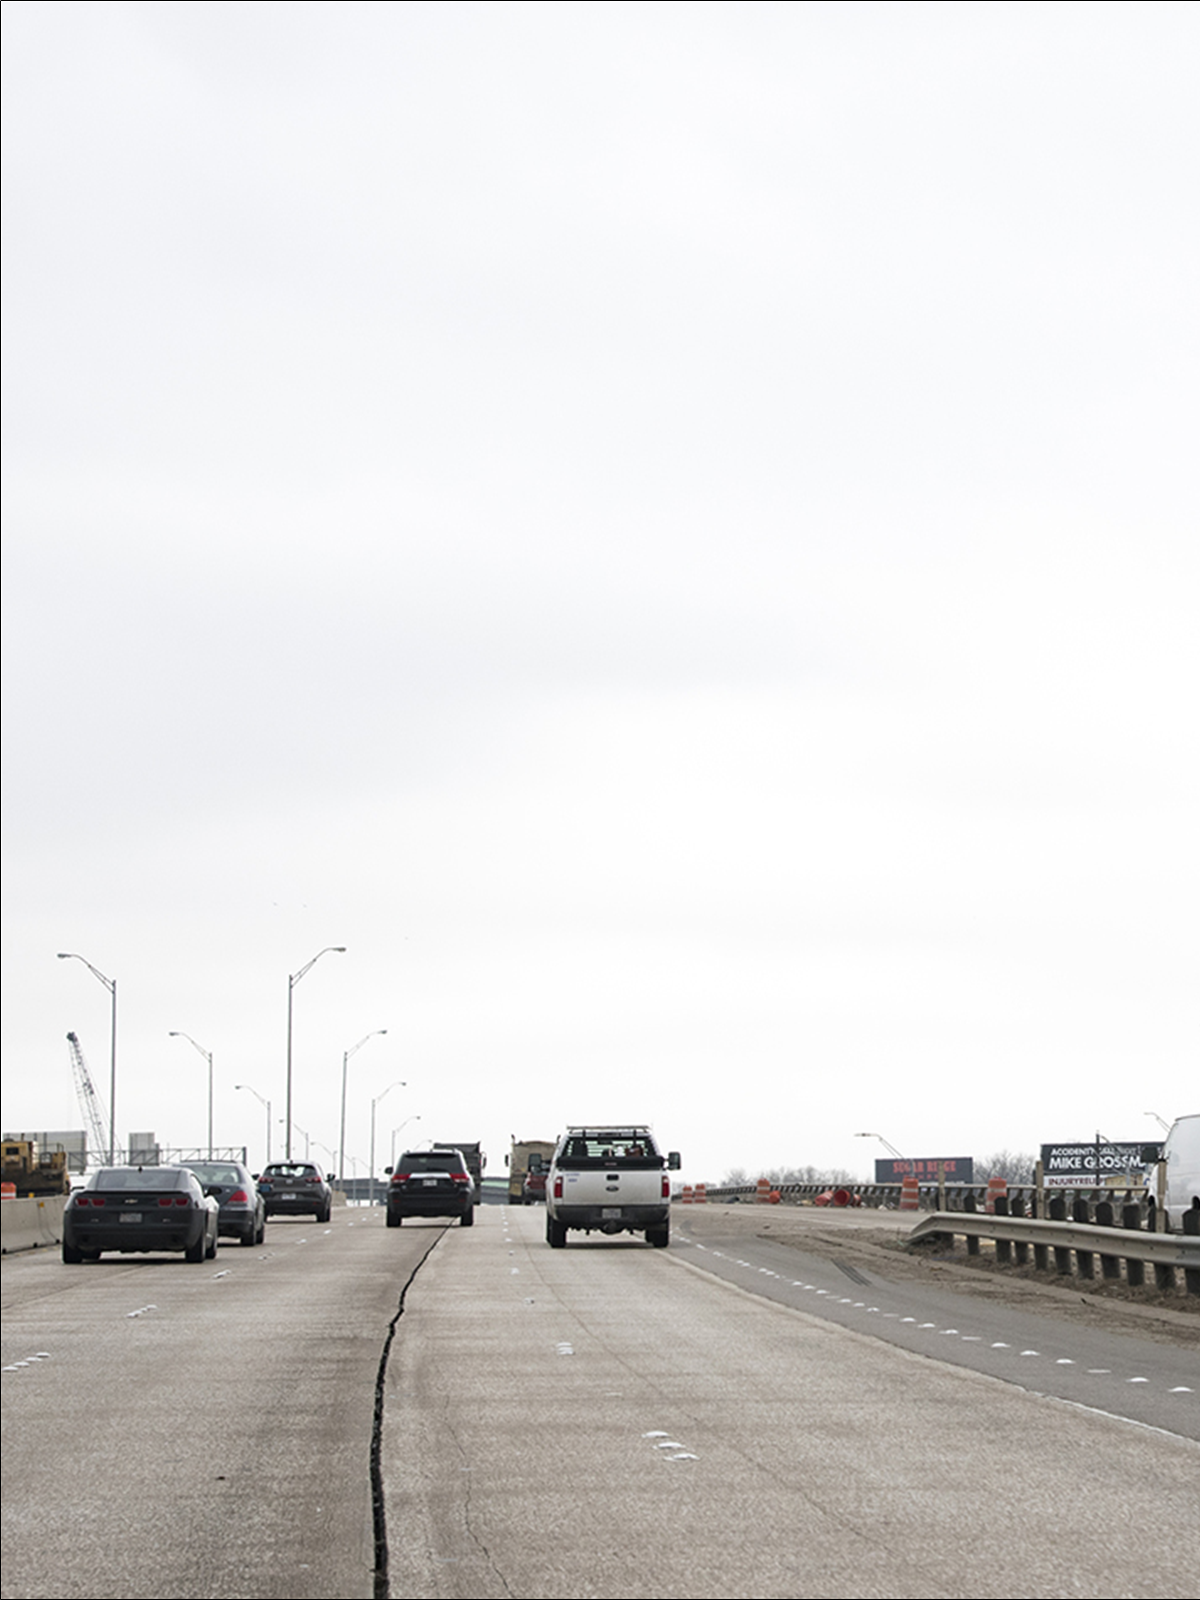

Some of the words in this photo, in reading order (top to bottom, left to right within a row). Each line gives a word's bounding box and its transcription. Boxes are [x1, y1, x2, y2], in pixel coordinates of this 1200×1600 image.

[927, 1161, 956, 1172] RIGE
[1049, 1157, 1082, 1169] MIKE
[1084, 1156, 1147, 1169] GROSSM
